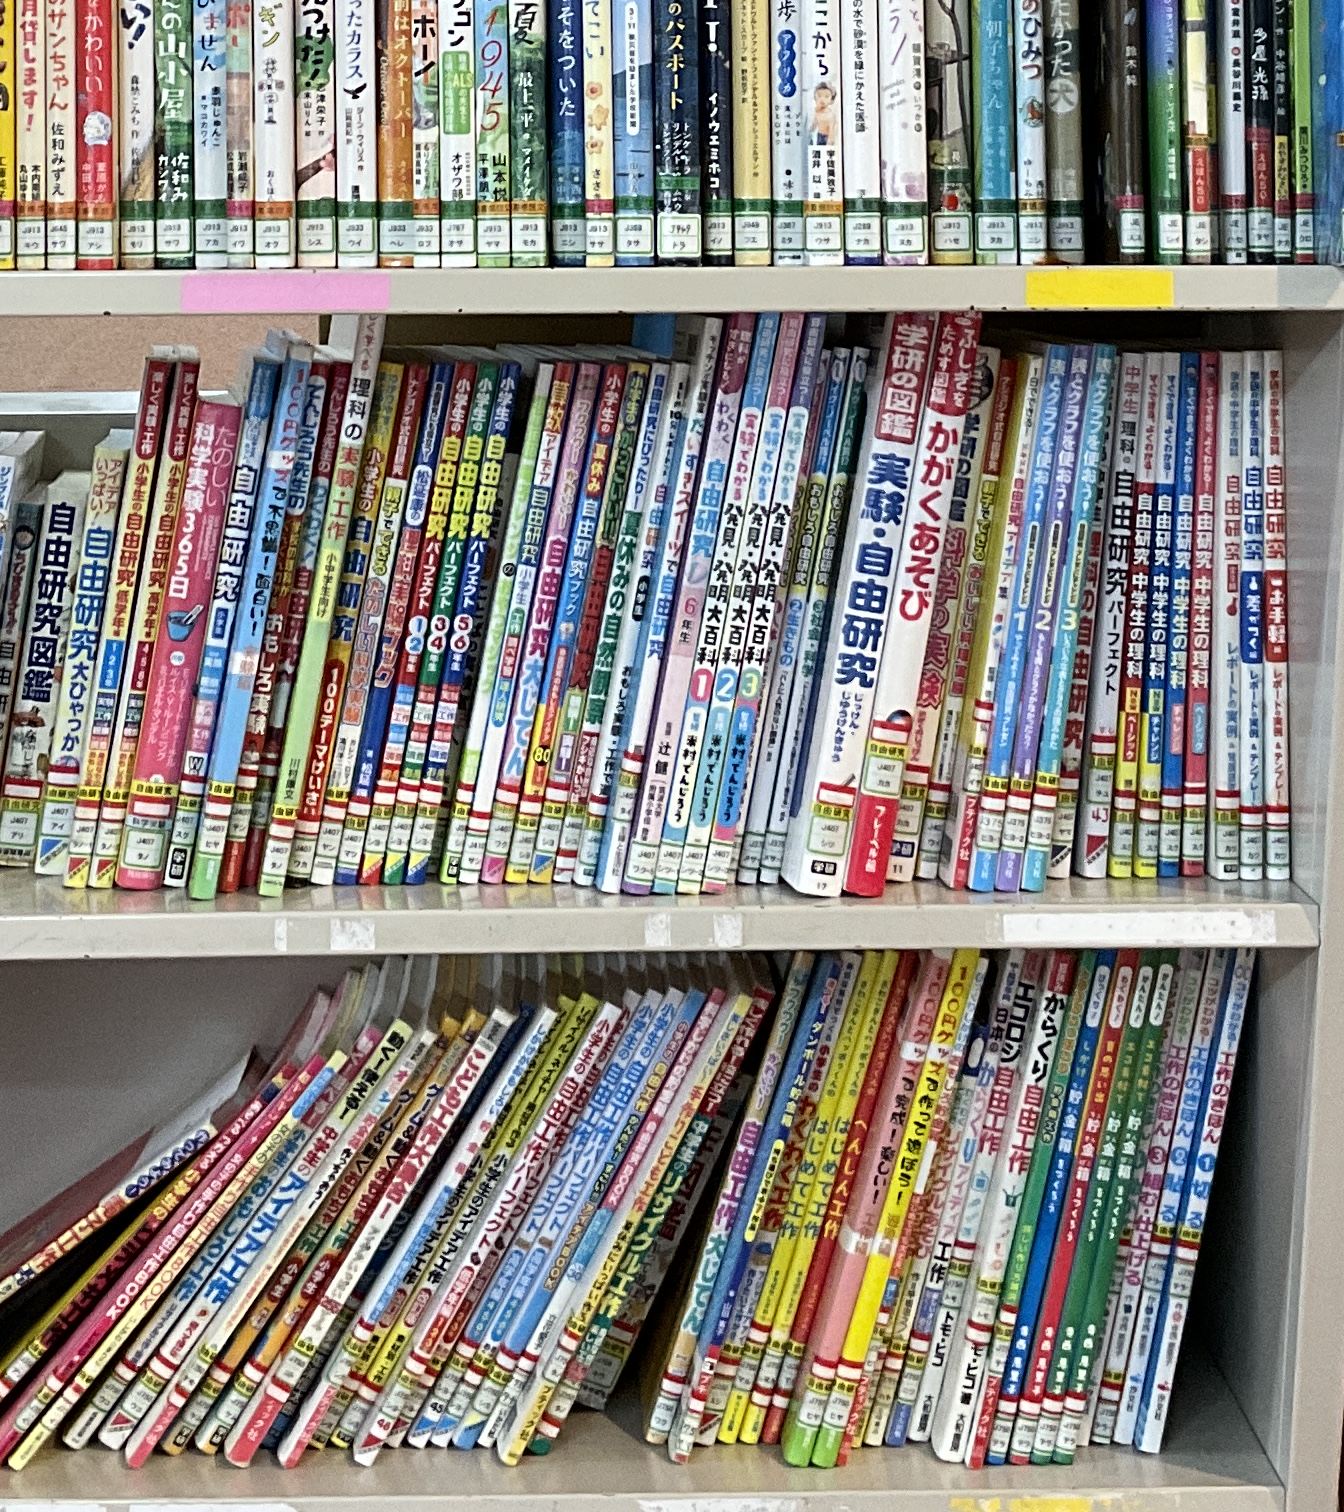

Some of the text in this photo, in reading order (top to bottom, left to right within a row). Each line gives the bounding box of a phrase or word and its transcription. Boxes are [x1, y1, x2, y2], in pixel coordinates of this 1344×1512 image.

[51, 122, 65, 196] 佐和みずえ
[708, 92, 721, 188] イノウエミホコ
[879, 321, 932, 438] 学研の図鑑
[167, 422, 215, 601] 科学実験365日
[897, 420, 961, 622] かがくあそび
[22, 502, 75, 705] 自由研究図鑑
[832, 451, 911, 690] 実験・自由研究
[1032, 993, 1065, 1083] からくり
[1009, 1085, 1043, 1175] 自由工作
[1203, 1051, 1235, 1143] 工作のきほん
